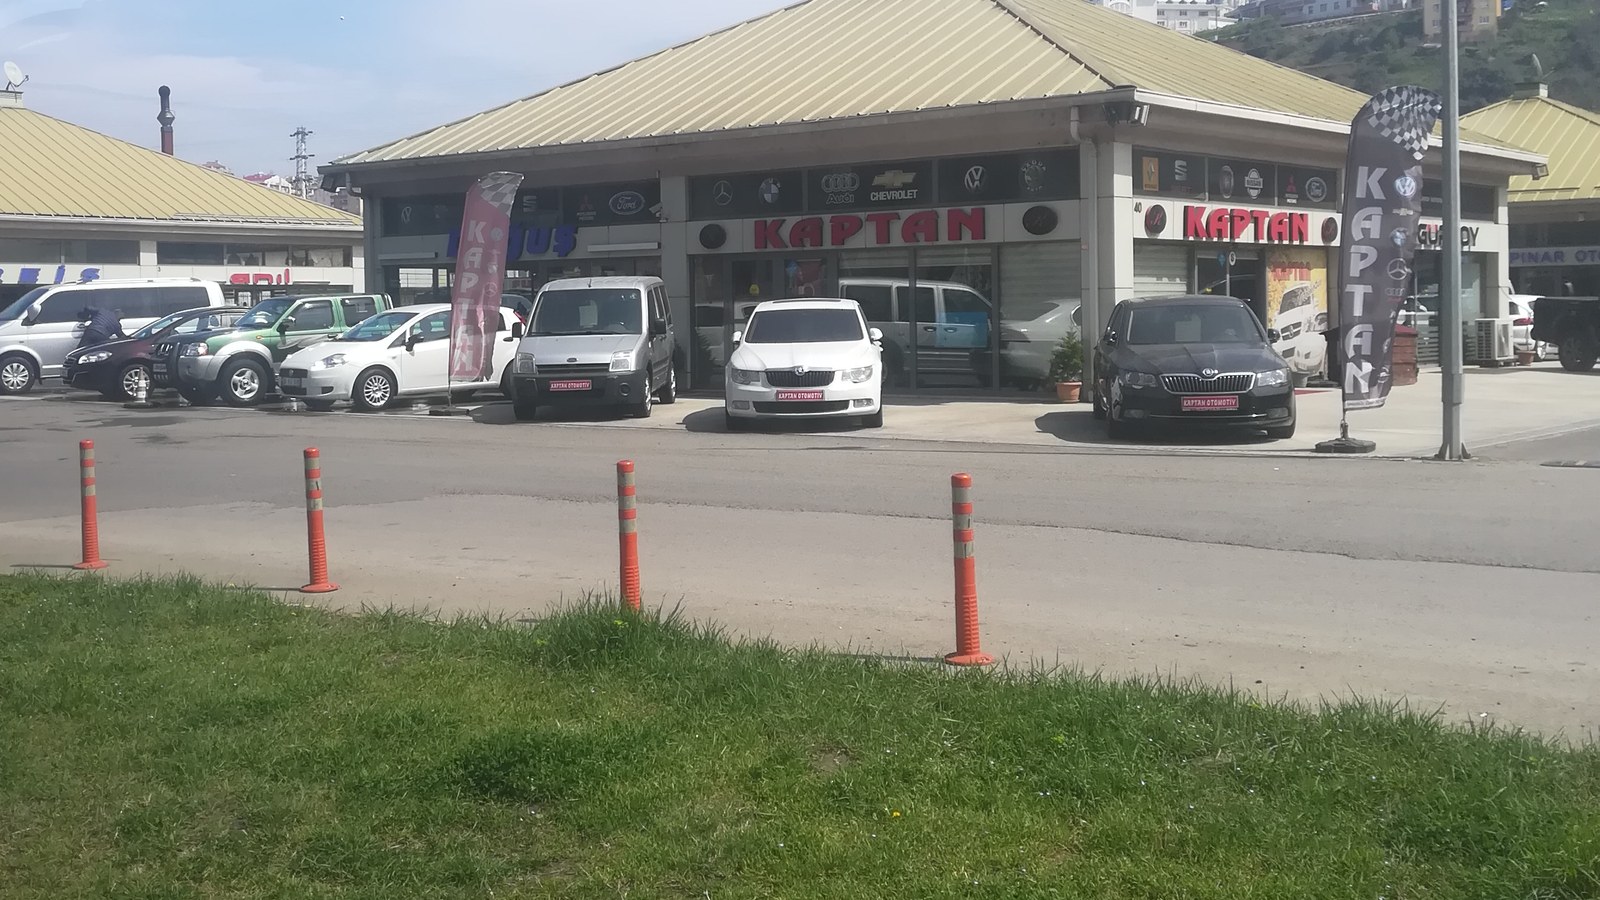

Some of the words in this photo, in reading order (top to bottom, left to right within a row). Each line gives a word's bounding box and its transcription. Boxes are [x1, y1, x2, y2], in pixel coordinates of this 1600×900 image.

[826, 193, 855, 205] Audi
[870, 189, 918, 202] CHEVROLET
[1134, 202, 1142, 212] 40
[754, 210, 987, 250] KAPTAN
[1184, 205, 1309, 243] KAPTAN
[1510, 251, 1565, 263] PINAR
[1343, 165, 1388, 394] KAPTAN
[453, 220, 488, 372] KAPTAN
